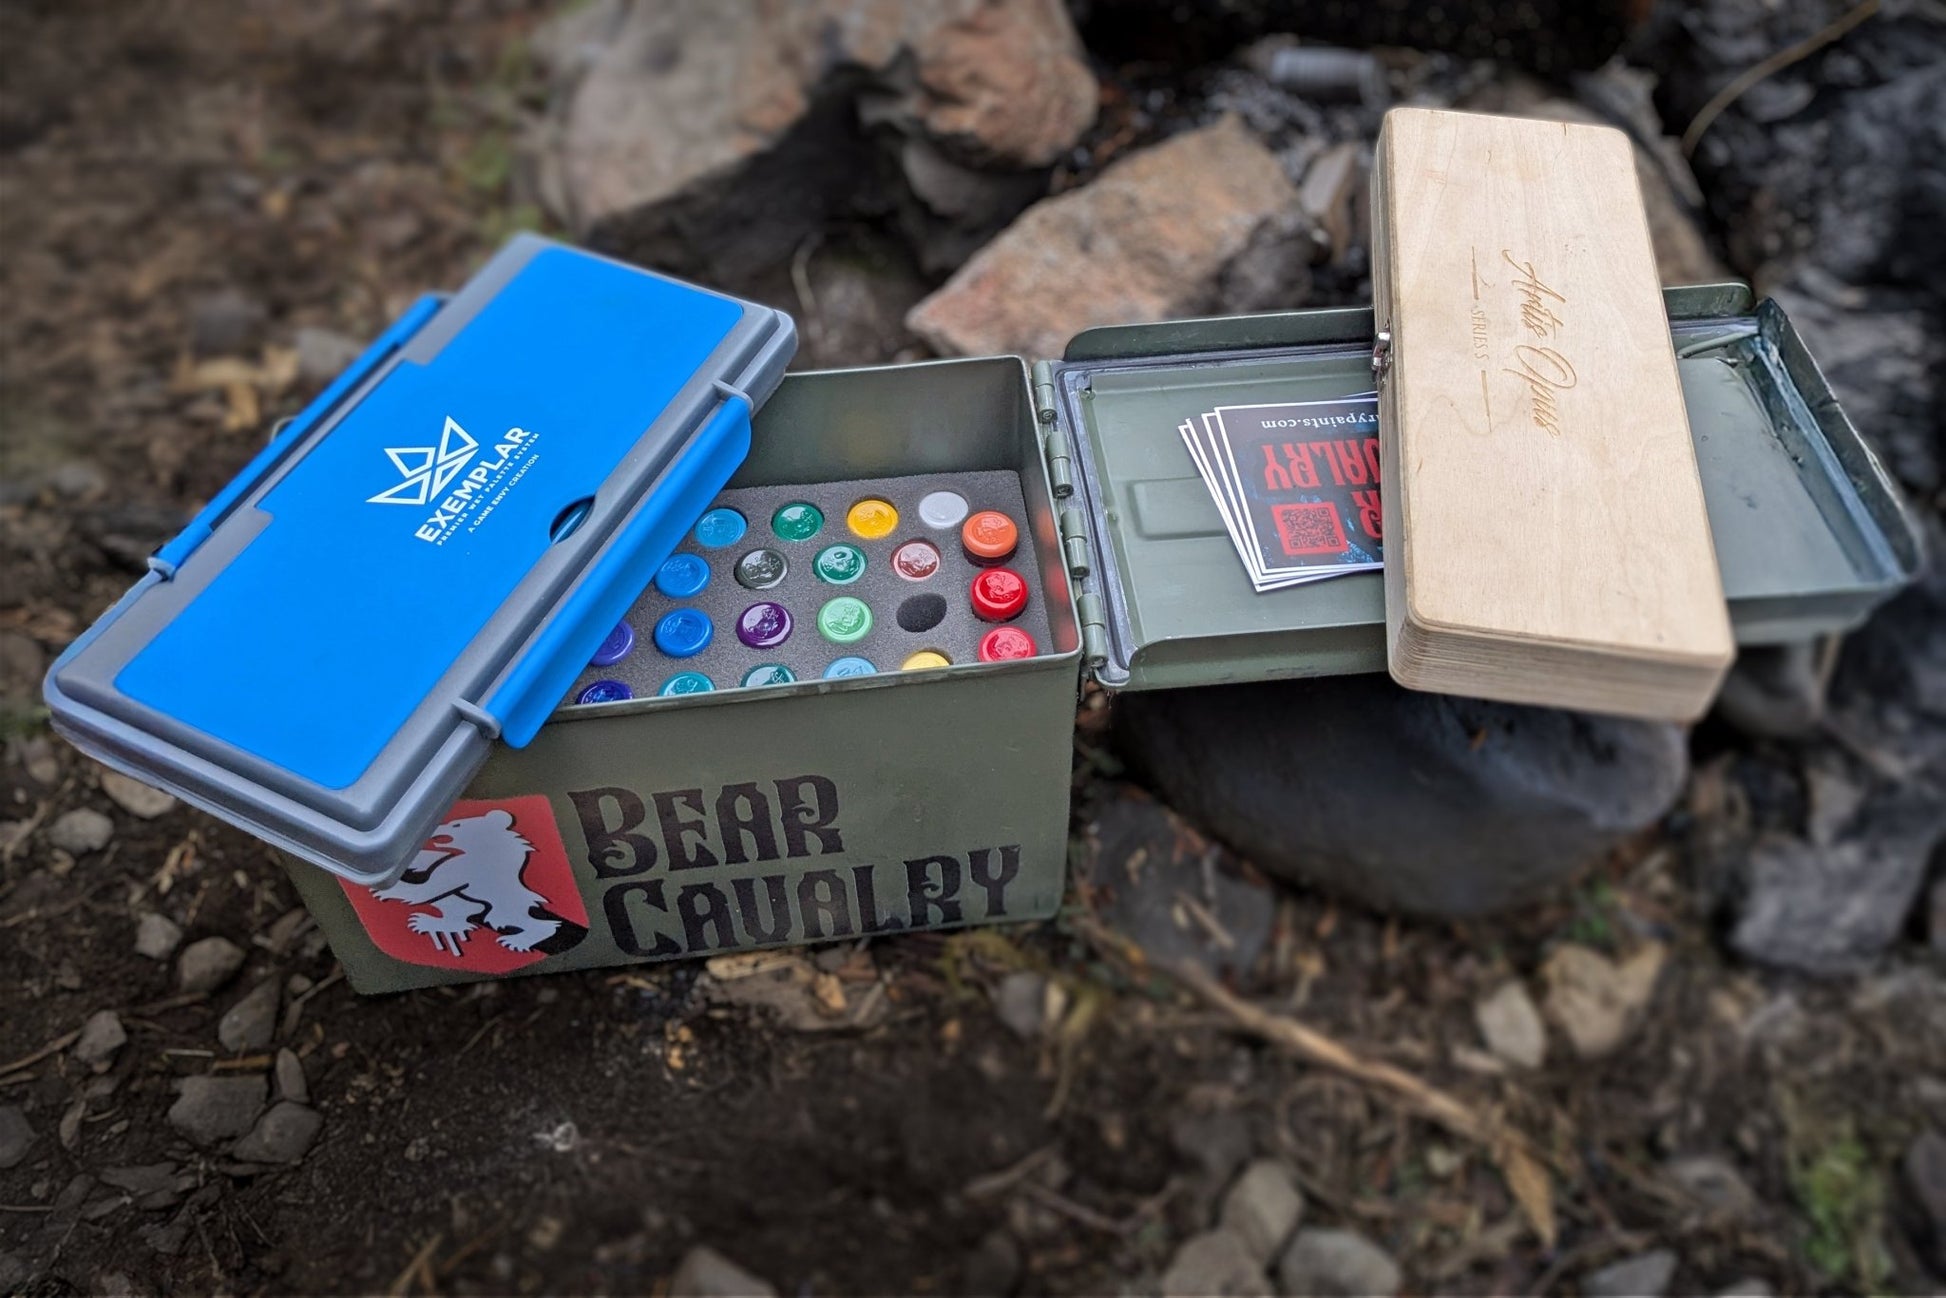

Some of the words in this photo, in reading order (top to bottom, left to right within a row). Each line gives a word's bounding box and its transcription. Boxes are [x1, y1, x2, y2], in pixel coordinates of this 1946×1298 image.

[1471, 309, 1489, 349] SERIES
[1261, 412, 1379, 429] rypaints.com
[1502, 345, 1577, 438] Opus
[415, 427, 531, 542] EXEMPLAR
[437, 512, 469, 546] PREMIER
[468, 494, 485, 510] WET
[484, 462, 514, 493] PALETTE
[514, 433, 540, 460] SYSTEM
[473, 504, 494, 526] GAME
[493, 487, 510, 506] ENVY
[508, 454, 540, 487] CREATION
[567, 774, 844, 879] BEAR
[602, 845, 1022, 957] CAVALRY
